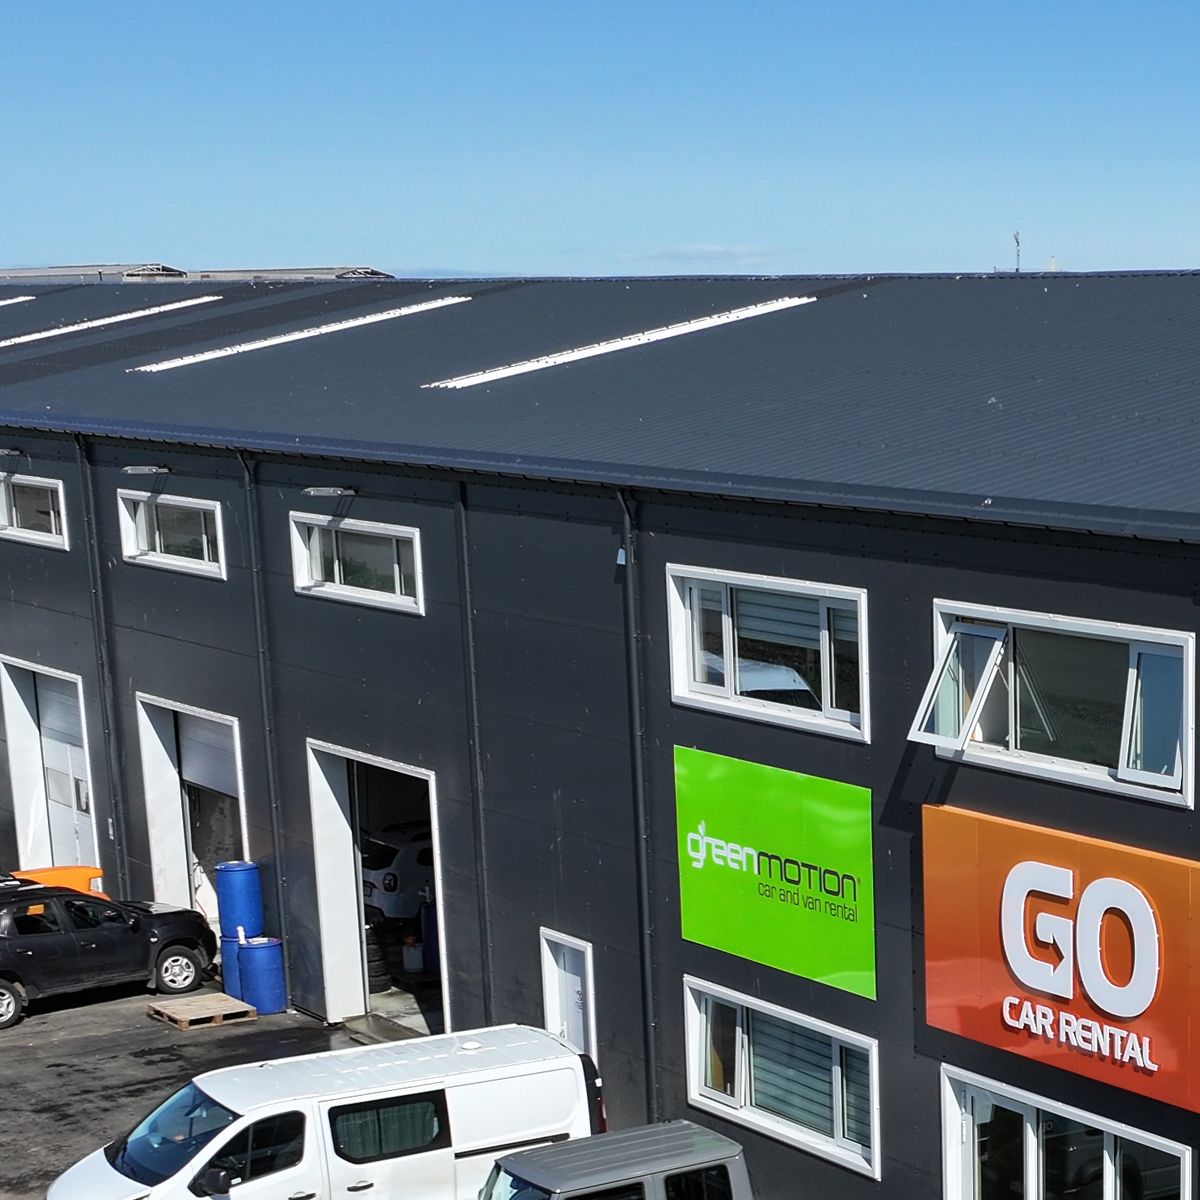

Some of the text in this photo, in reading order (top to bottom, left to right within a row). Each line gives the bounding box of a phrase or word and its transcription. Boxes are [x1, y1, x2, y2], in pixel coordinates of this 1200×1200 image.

[758, 882, 858, 923] car and van rental
[1001, 861, 1159, 1018] GO
[1003, 996, 1158, 1071] CAR RENTAL
